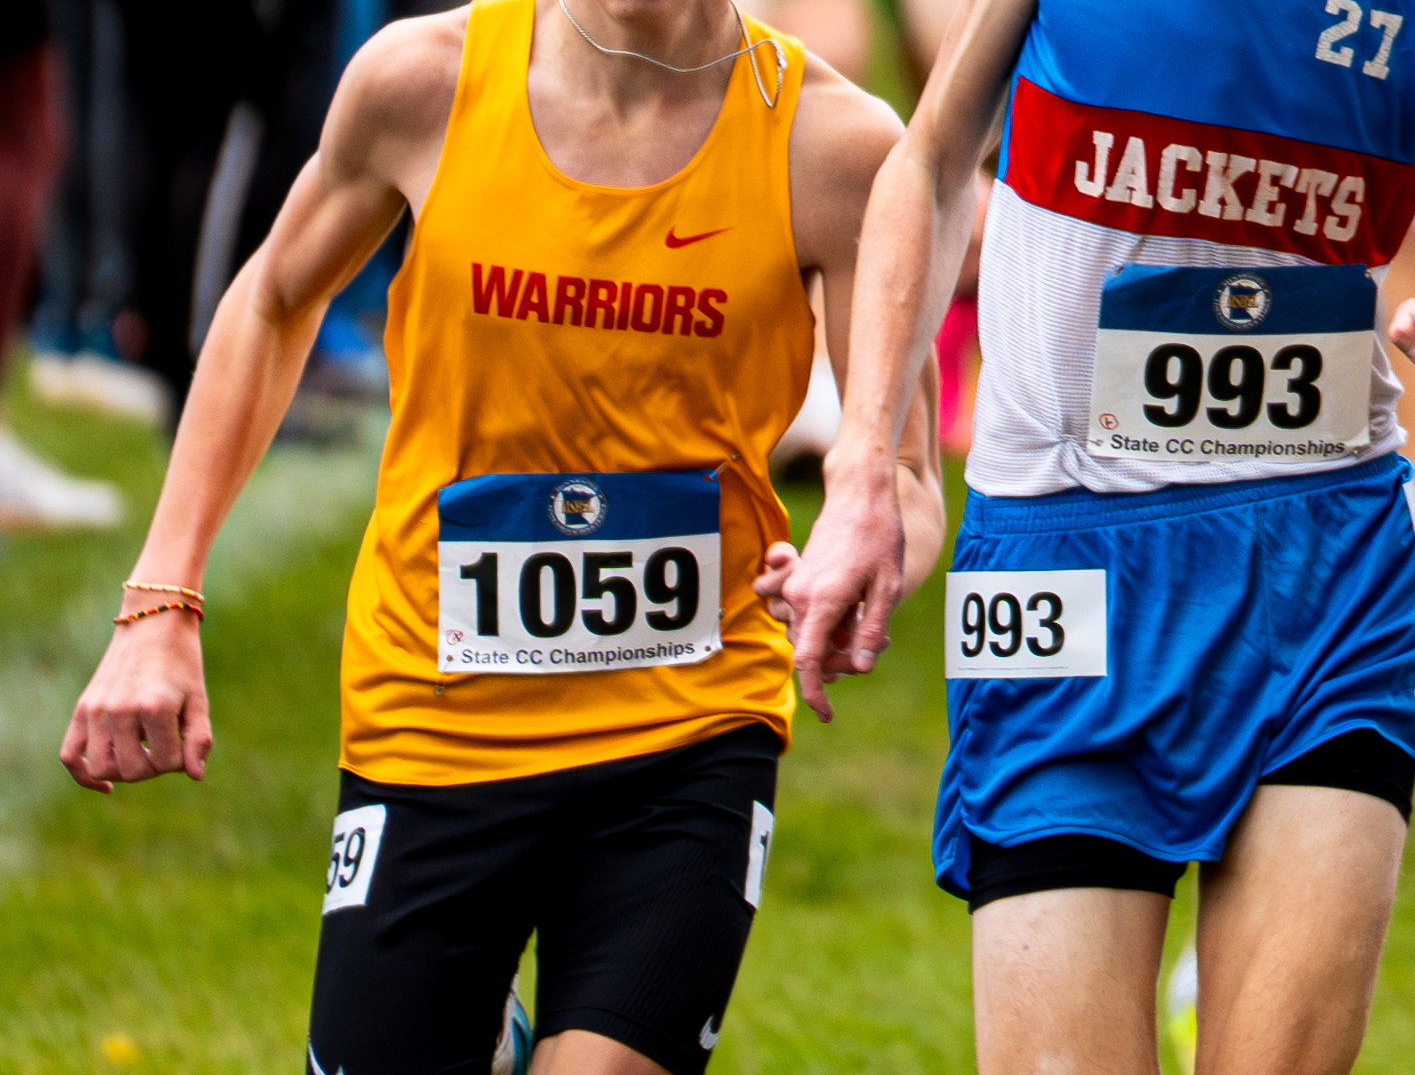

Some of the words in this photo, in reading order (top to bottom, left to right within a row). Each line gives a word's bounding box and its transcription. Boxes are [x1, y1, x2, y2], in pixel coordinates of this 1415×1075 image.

[1074, 130, 1366, 242] JACKETS
[471, 262, 728, 338] WARRIORS
[1143, 342, 1323, 430] 993
[1110, 434, 1159, 453] State
[1165, 438, 1194, 455] CC
[1200, 439, 1345, 458] Championships
[459, 546, 699, 639] 1059
[960, 591, 1065, 658] 993
[461, 649, 509, 664] State
[515, 649, 543, 665] CC
[550, 641, 695, 665] Championships
